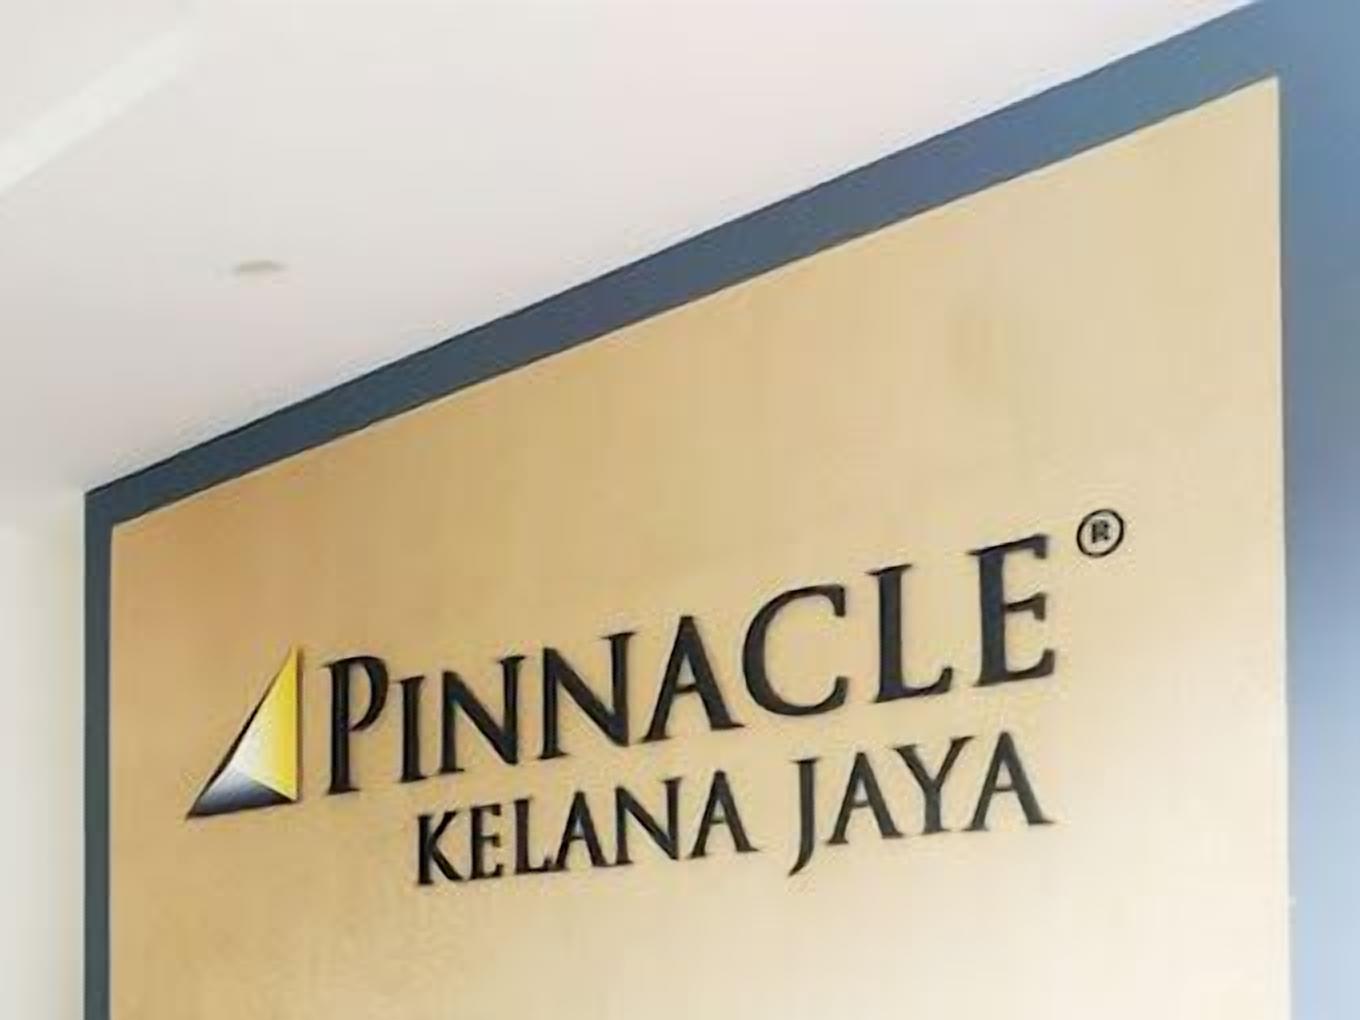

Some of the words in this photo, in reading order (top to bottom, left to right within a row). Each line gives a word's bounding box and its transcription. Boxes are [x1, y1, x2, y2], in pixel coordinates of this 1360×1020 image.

[322, 533, 1056, 795] PINNACLE
[416, 769, 758, 886] KELANA
[787, 731, 1054, 877] JAYA
